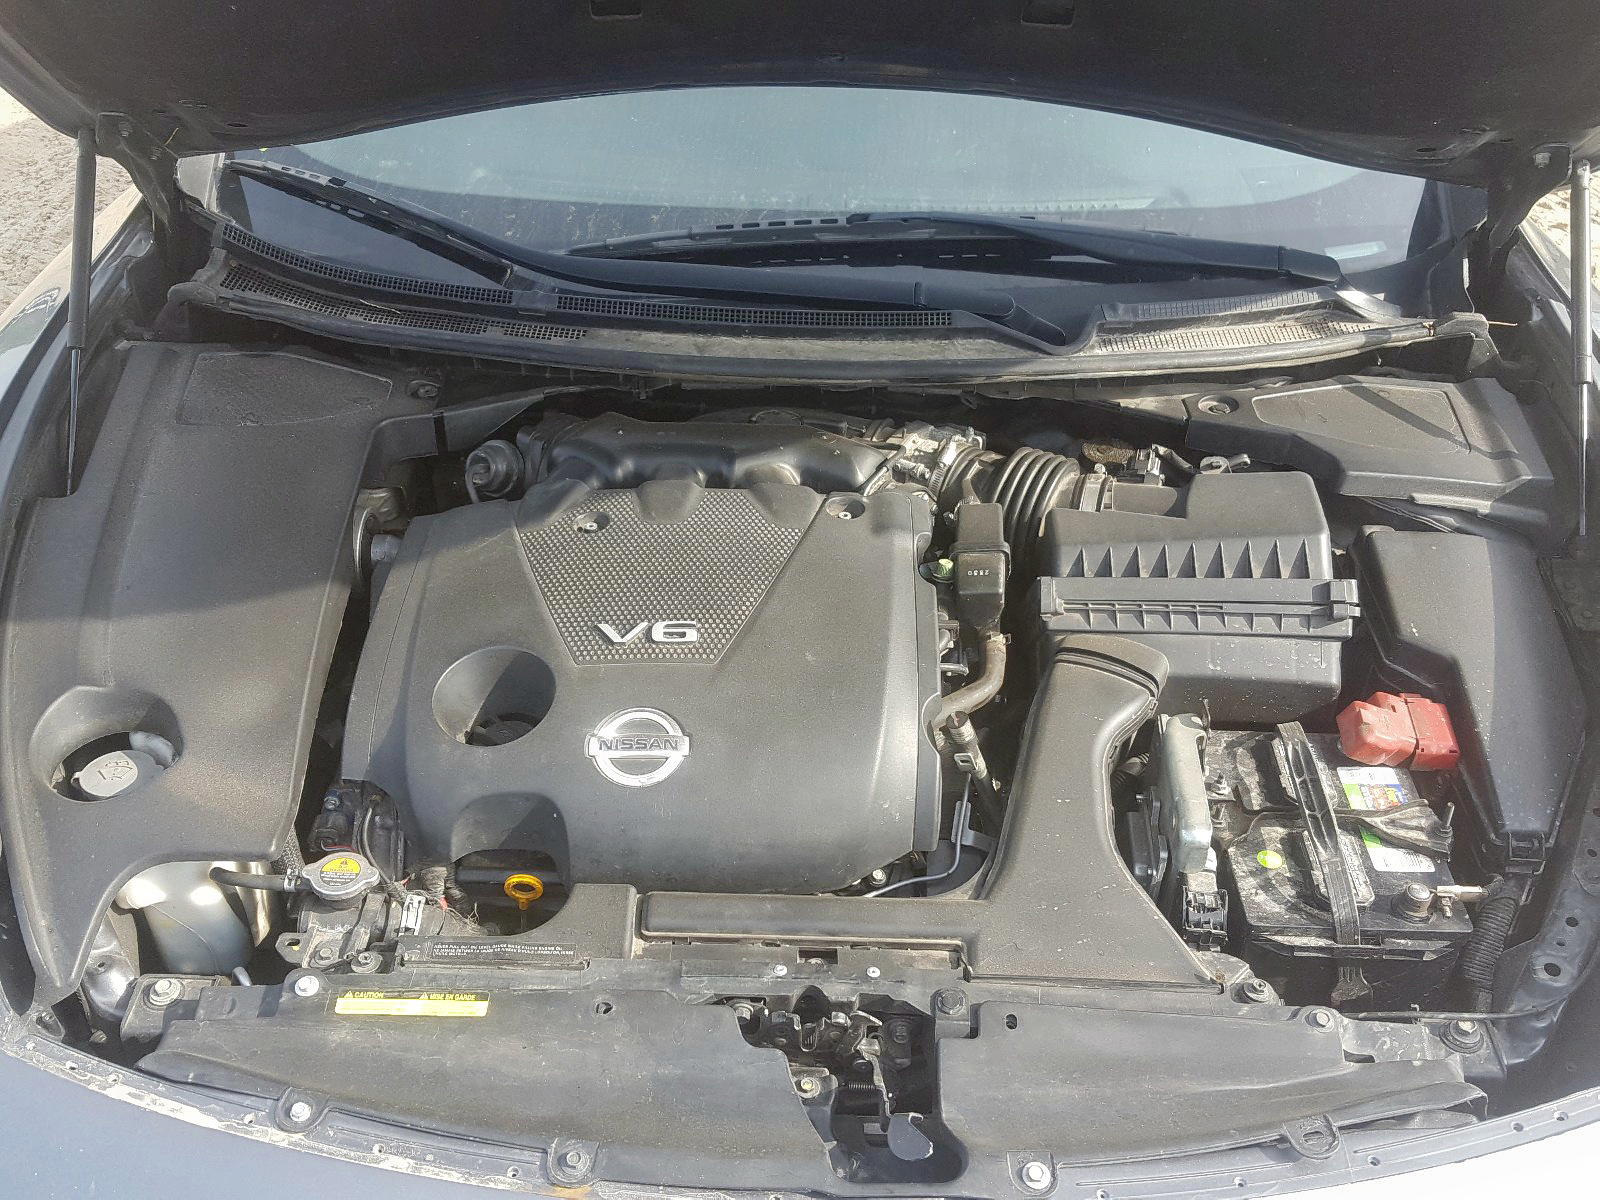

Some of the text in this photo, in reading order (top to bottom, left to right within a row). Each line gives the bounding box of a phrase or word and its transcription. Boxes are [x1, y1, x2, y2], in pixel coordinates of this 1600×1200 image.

[595, 620, 698, 644] V6
[599, 737, 679, 751] NISSAN
[354, 991, 384, 999] CAUTION
[455, 993, 477, 1001] GARDE
